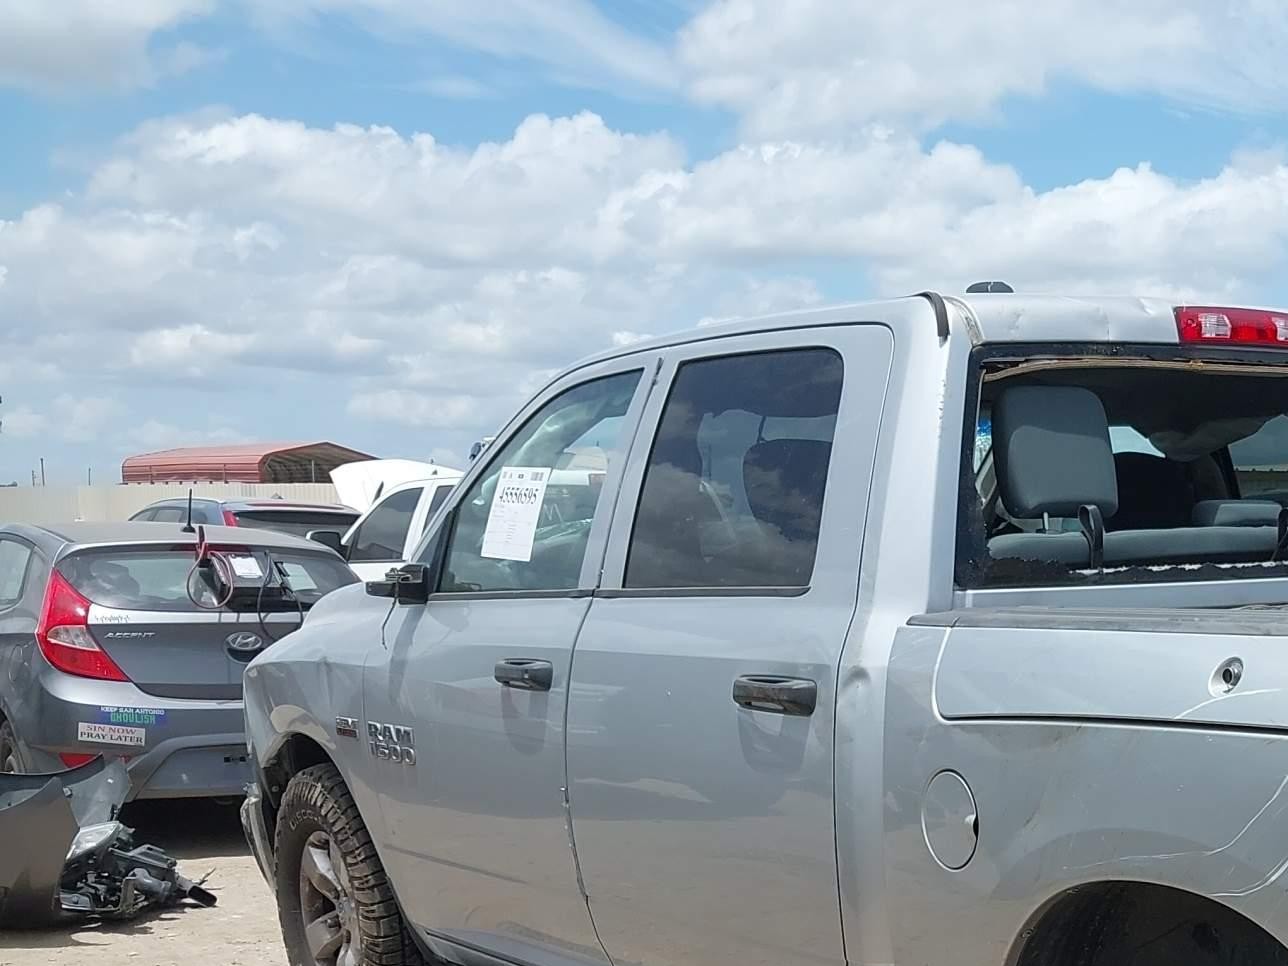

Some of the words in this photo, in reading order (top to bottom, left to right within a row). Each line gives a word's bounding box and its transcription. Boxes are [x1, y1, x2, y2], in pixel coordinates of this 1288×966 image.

[135, 708, 165, 716] ANTONIO
[86, 725, 106, 733] SIN
[108, 727, 137, 735] NOW
[367, 720, 415, 745] RAM
[80, 731, 110, 740] PRAY
[109, 733, 143, 744] LATER
[368, 740, 417, 766] 1500
